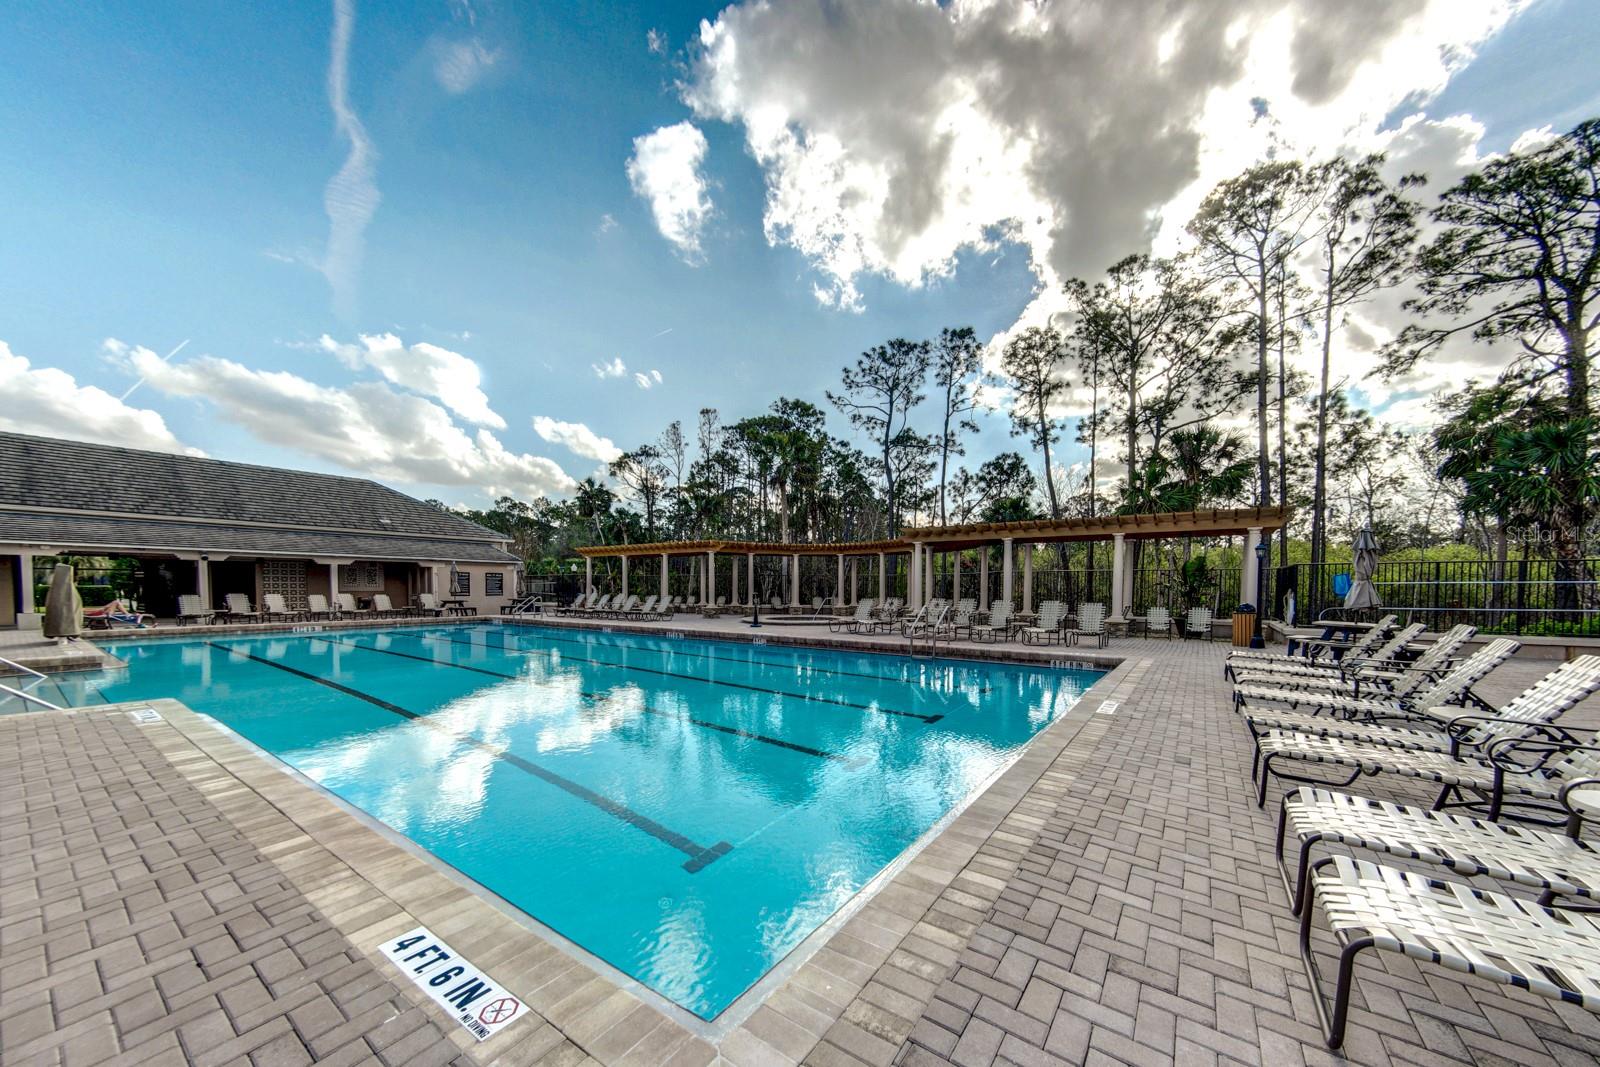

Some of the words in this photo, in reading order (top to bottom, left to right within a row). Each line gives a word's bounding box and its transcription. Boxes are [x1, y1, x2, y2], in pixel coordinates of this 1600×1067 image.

[393, 935, 426, 953] 4
[403, 945, 450, 973] FT.
[429, 967, 465, 986] 6
[444, 978, 492, 1012] IN.
[460, 1013, 474, 1023] NO
[467, 1020, 490, 1038] DIVING
